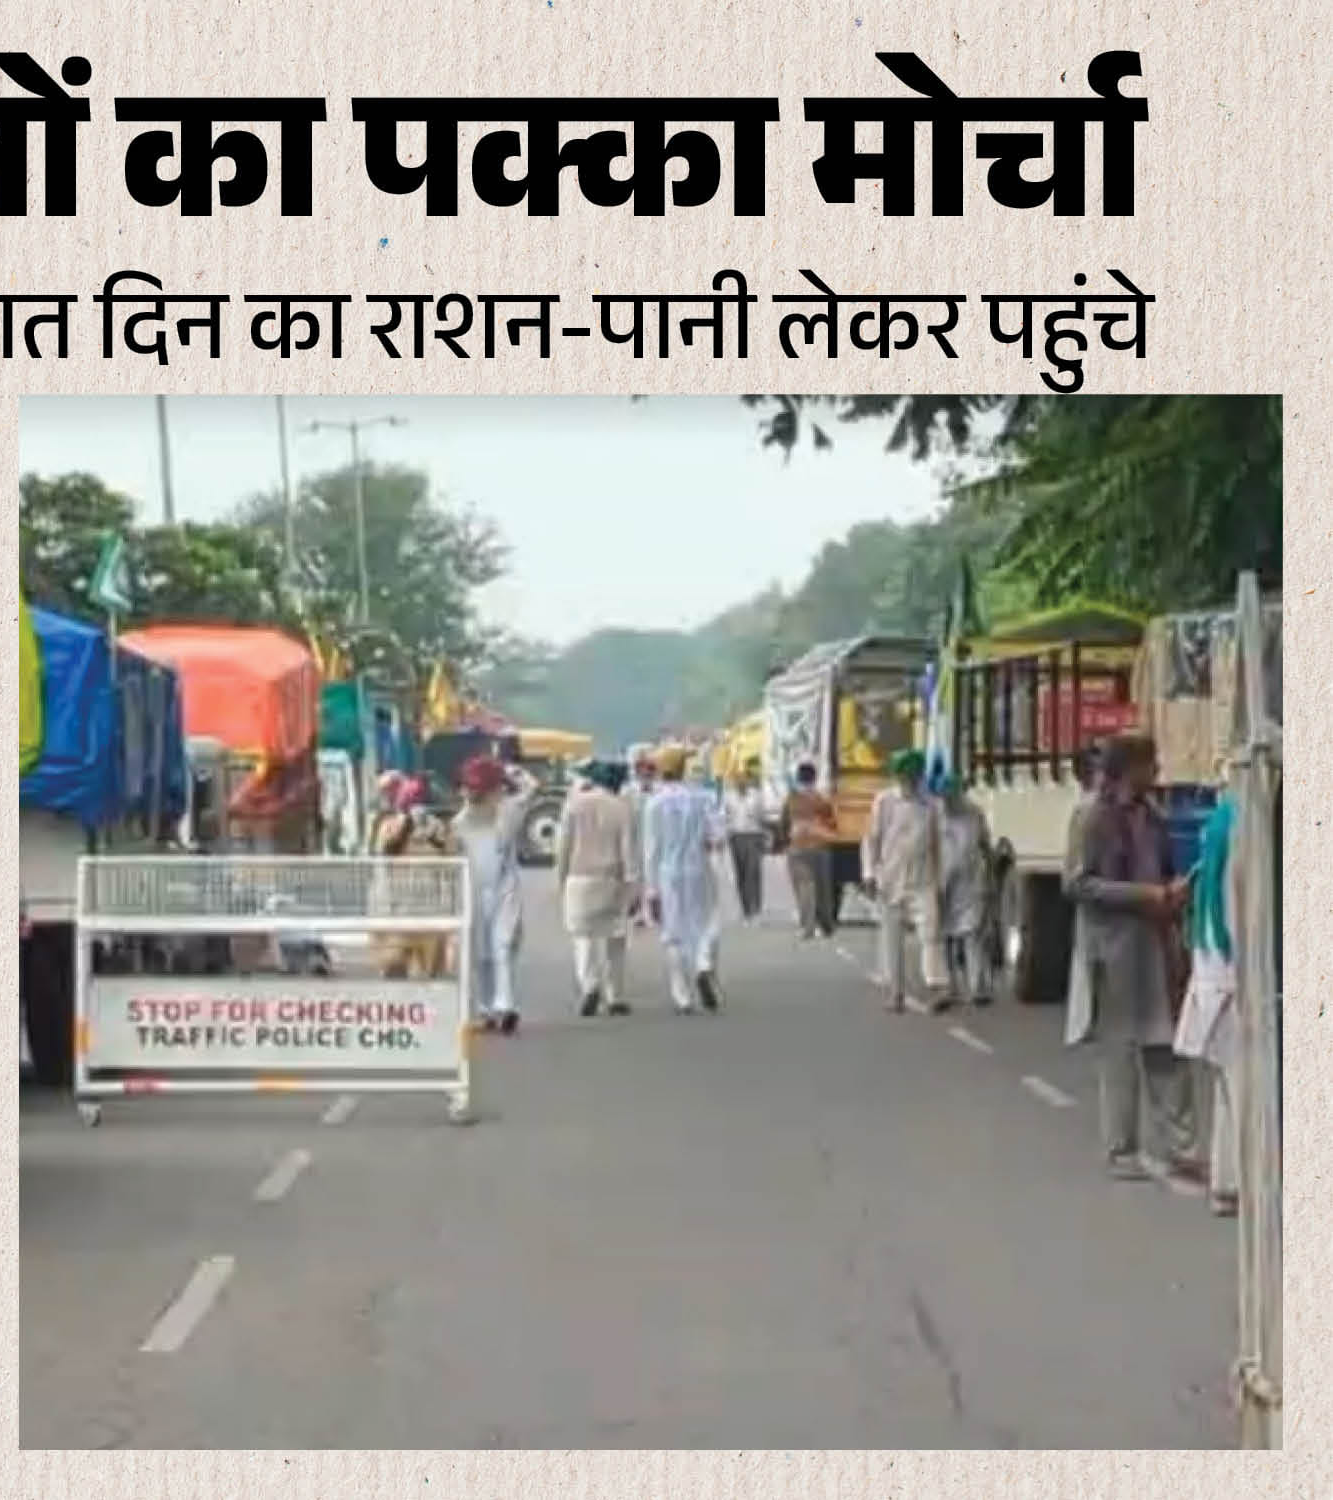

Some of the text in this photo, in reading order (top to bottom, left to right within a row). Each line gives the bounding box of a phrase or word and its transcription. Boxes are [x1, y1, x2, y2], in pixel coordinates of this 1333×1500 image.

[127, 999, 428, 1026] STOP FOR CHECKING
[136, 1026, 249, 1049] TRAFFIC
[256, 1026, 349, 1050] POLICE
